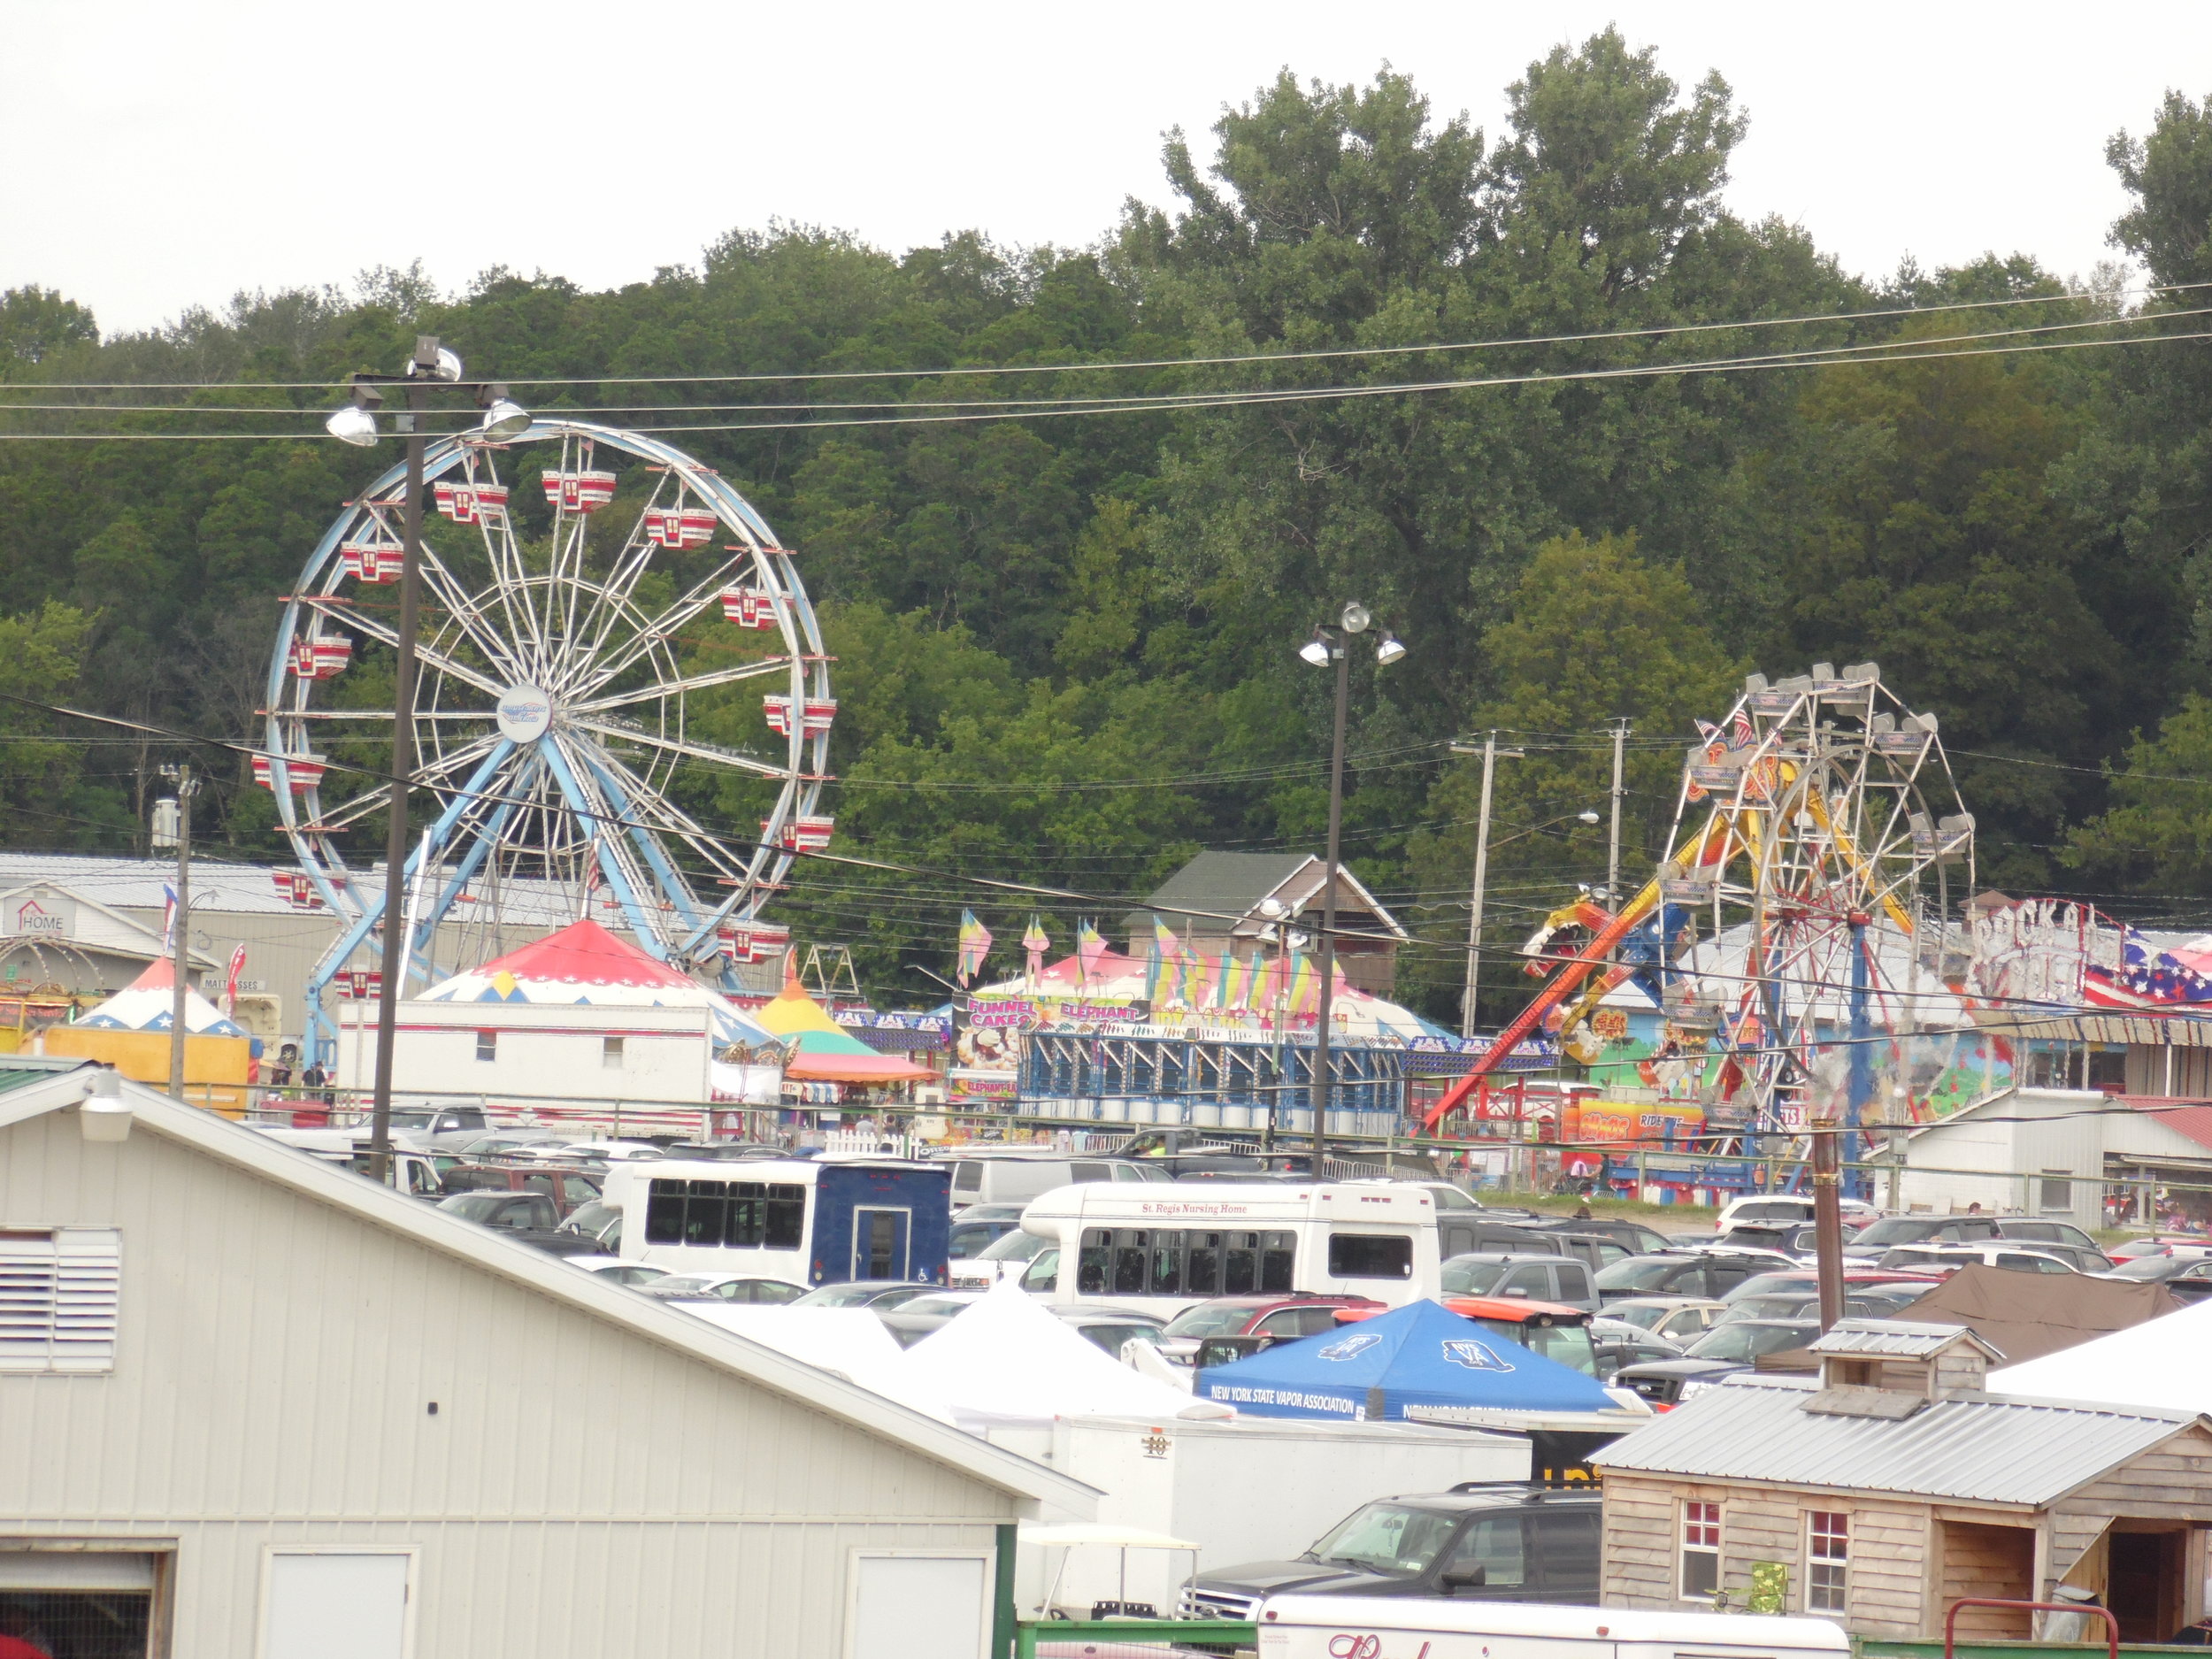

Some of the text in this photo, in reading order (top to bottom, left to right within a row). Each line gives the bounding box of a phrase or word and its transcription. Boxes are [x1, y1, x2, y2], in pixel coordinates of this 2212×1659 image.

[23, 917, 64, 930] HOME
[204, 979, 258, 990] MATTSSES
[967, 997, 1038, 1018] FUNNEL
[1061, 1002, 1140, 1022] ELEPHANT
[1640, 1114, 1664, 1127] RIDE
[1156, 1203, 1181, 1216] Regis
[1182, 1203, 1219, 1216] Nursing
[1219, 1204, 1248, 1214] Home
[1211, 1385, 1231, 1402] NEW
[1231, 1386, 1253, 1402] YORK
[1253, 1388, 1275, 1404] STATE
[1276, 1390, 1303, 1409] VAPOR
[1302, 1394, 1356, 1415] ASSOCIATION
